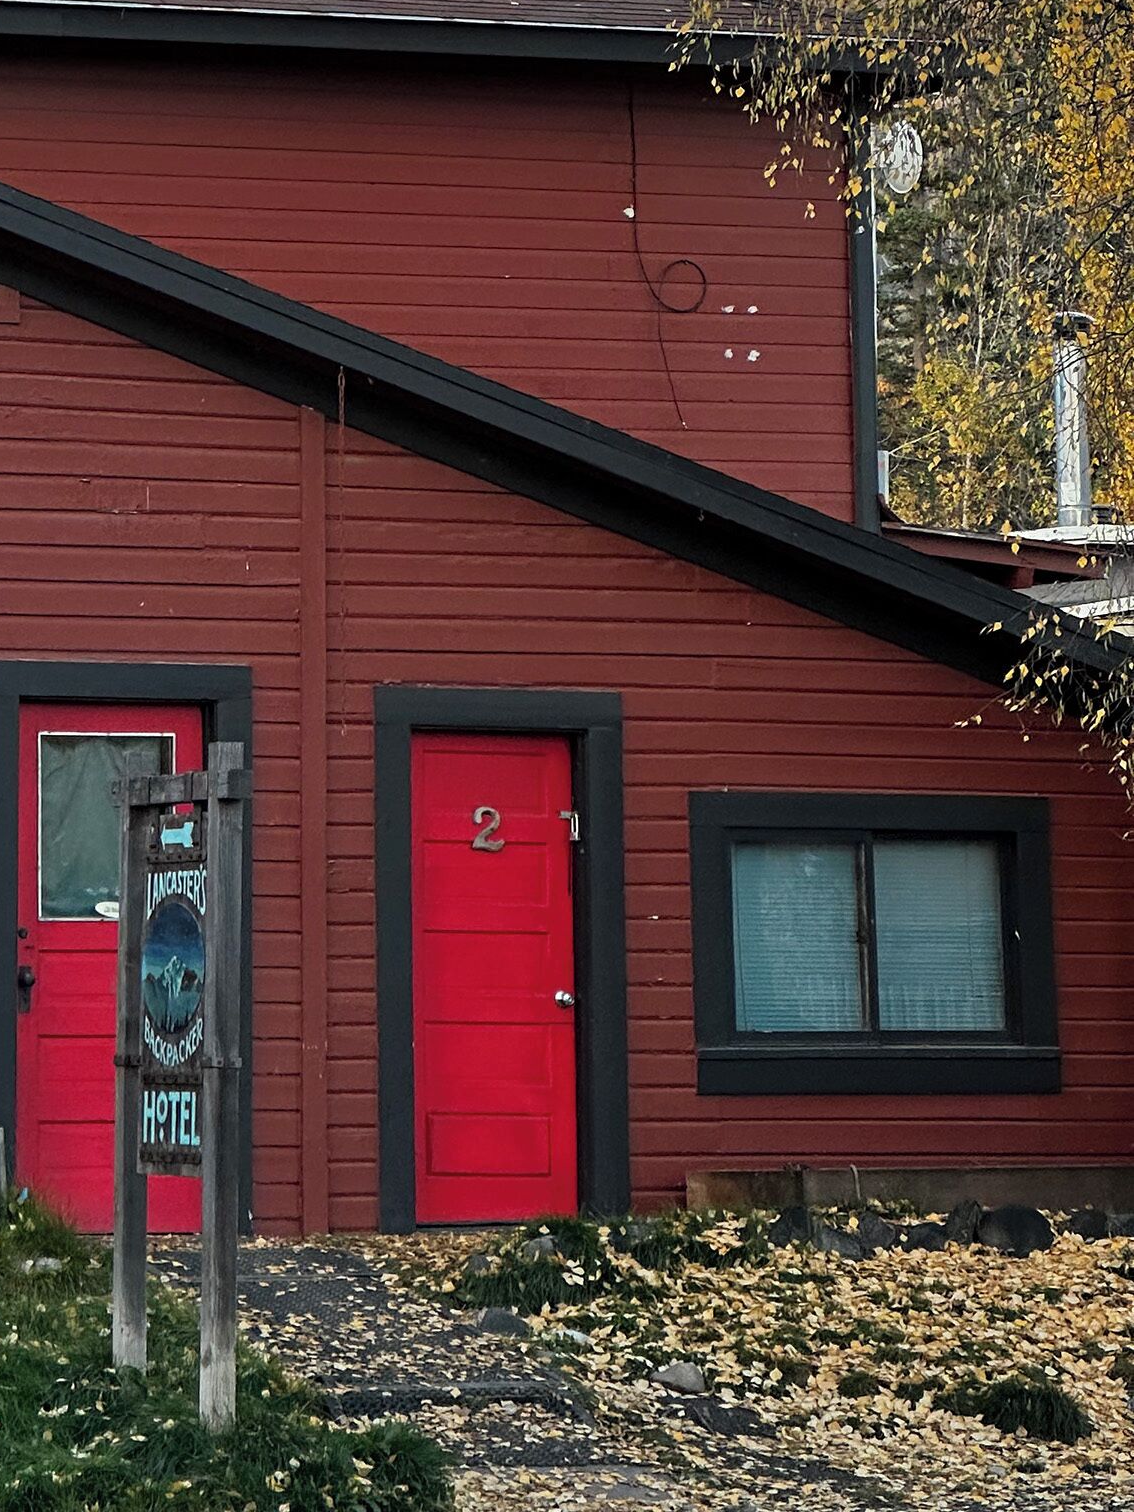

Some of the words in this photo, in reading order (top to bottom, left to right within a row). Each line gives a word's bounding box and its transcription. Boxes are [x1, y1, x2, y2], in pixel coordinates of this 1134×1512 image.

[472, 805, 506, 851] 2
[146, 863, 207, 920] LANCASTER'S
[144, 1015, 203, 1067] BACKPACKER
[142, 1090, 201, 1146] HOTEL
